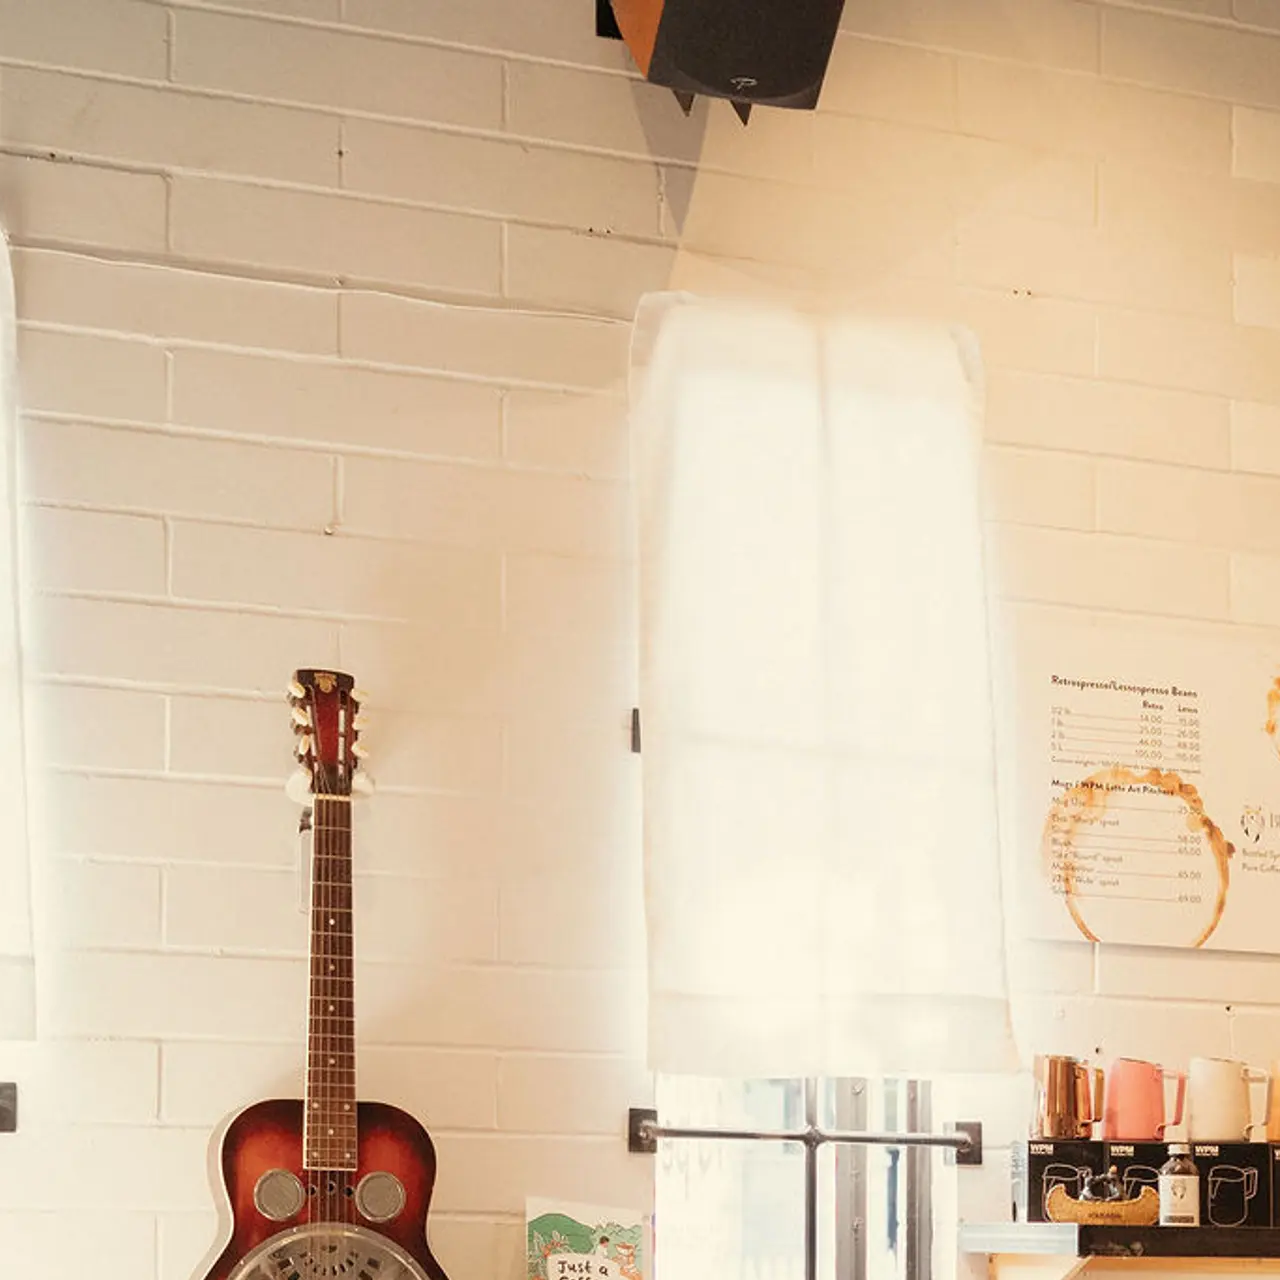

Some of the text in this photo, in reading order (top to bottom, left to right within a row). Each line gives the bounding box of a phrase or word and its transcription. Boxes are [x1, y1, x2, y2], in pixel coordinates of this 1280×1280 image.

[1171, 686, 1198, 698] Beans
[557, 1260, 609, 1276] Just a
